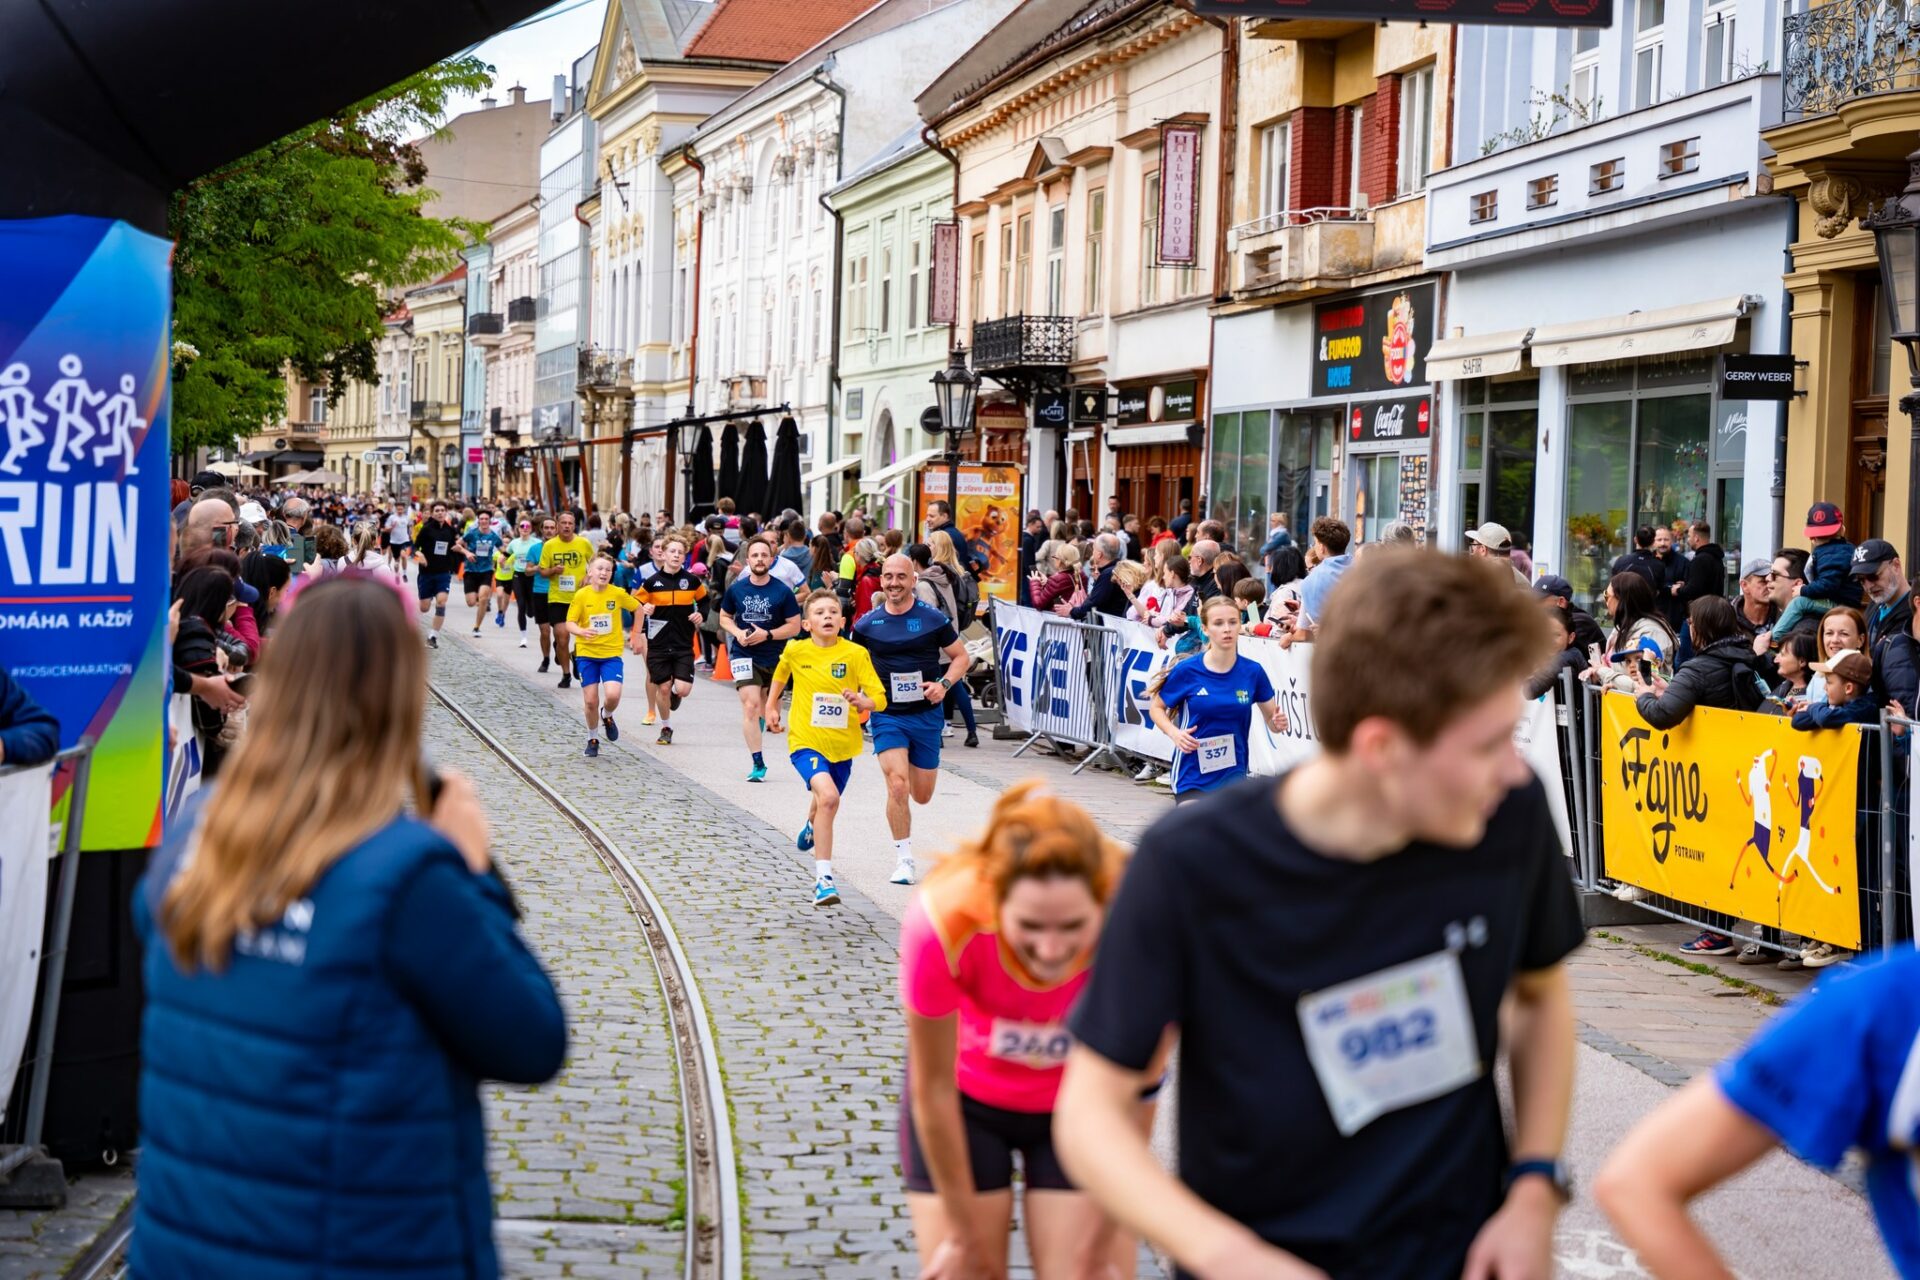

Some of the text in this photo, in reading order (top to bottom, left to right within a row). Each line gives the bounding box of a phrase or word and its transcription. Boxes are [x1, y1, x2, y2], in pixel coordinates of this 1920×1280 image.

[1173, 135, 1187, 254] HALMIHO DVOR
[1725, 371, 1792, 382] GERRY WEBER
[0, 481, 139, 585] RUN
[1853, 546, 1868, 562] NY
[79, 609, 133, 627] KAŽDÝ
[897, 682, 918, 692] 253
[818, 704, 843, 716] 230
[1204, 745, 1228, 760] 337
[1619, 727, 1708, 864] Fajne
[1674, 845, 1705, 863] POTRAVINY
[1339, 1008, 1437, 1070] 982
